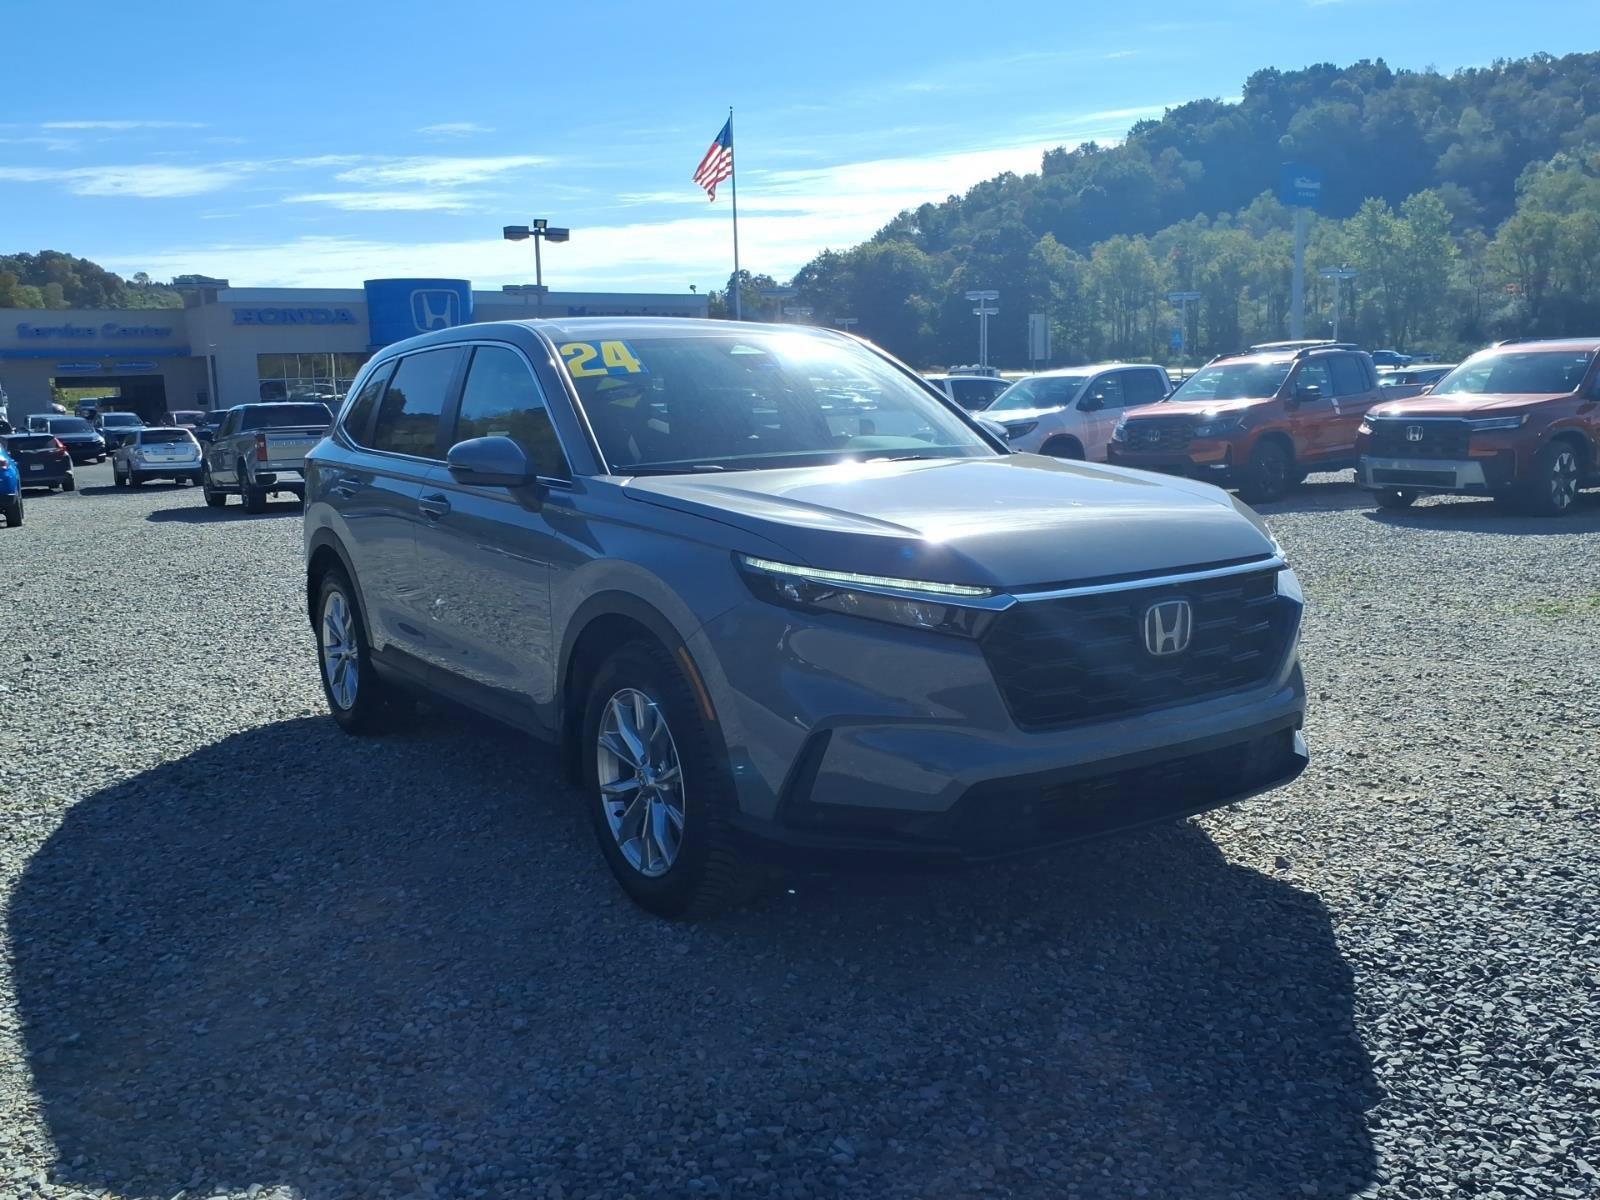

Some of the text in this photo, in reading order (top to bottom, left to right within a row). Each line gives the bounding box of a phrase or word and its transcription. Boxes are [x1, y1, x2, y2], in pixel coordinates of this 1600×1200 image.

[233, 308, 357, 326] HONDA
[16, 323, 172, 339] Service Center
[560, 341, 641, 378] 24
